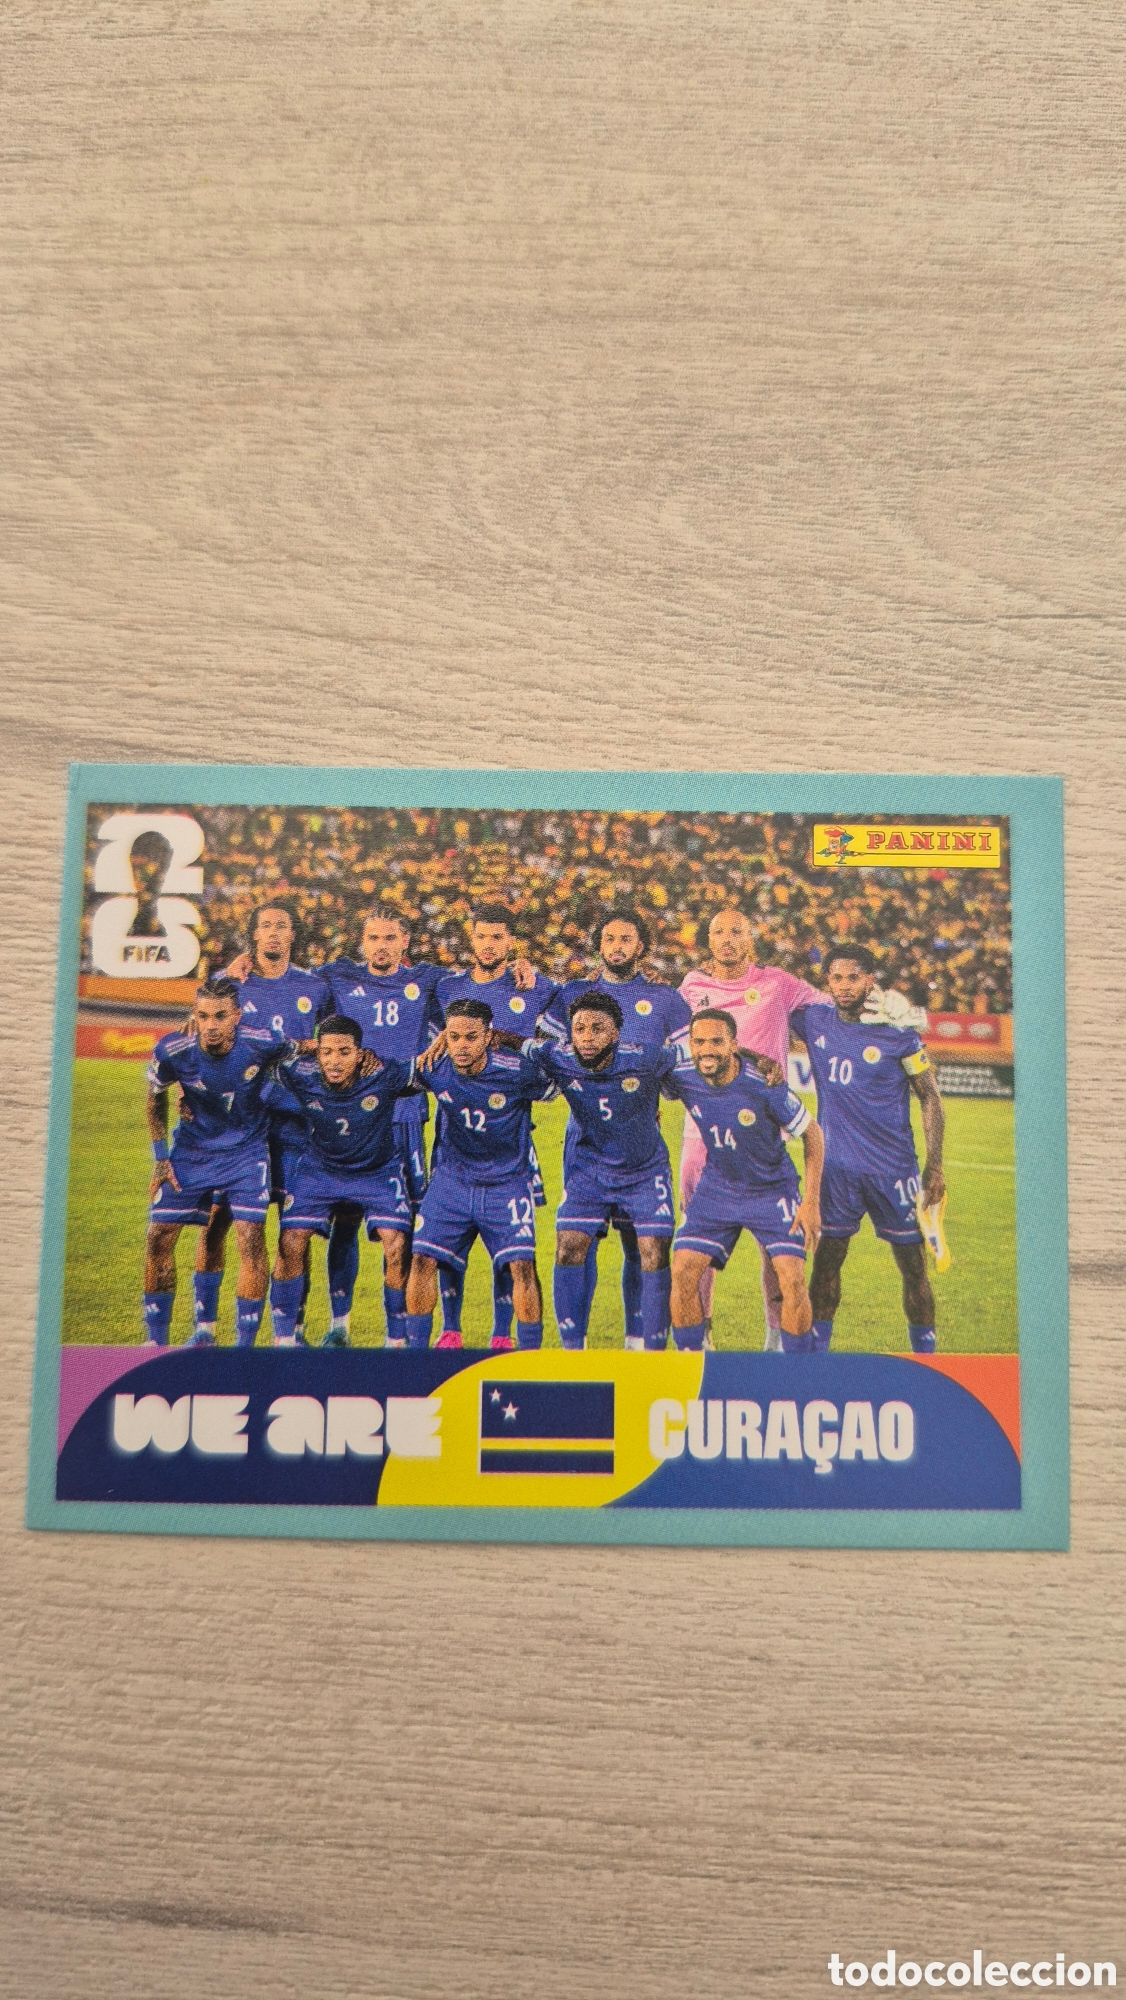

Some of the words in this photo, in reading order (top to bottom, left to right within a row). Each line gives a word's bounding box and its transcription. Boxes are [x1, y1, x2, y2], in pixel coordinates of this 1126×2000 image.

[867, 831, 992, 850] PANINI
[122, 945, 171, 963] FIFA
[372, 1000, 399, 1026] 18
[828, 1057, 852, 1085] 10
[222, 1092, 235, 1113] 7
[599, 1098, 613, 1121] 5
[336, 1117, 350, 1136] 2
[460, 1107, 487, 1133] 12
[709, 1125, 737, 1150] 14
[257, 1161, 268, 1186] 7
[654, 1175, 668, 1200] 5
[507, 1197, 533, 1225] 12
[113, 1394, 250, 1454] WE
[648, 1397, 915, 1474] CURAÇAO
